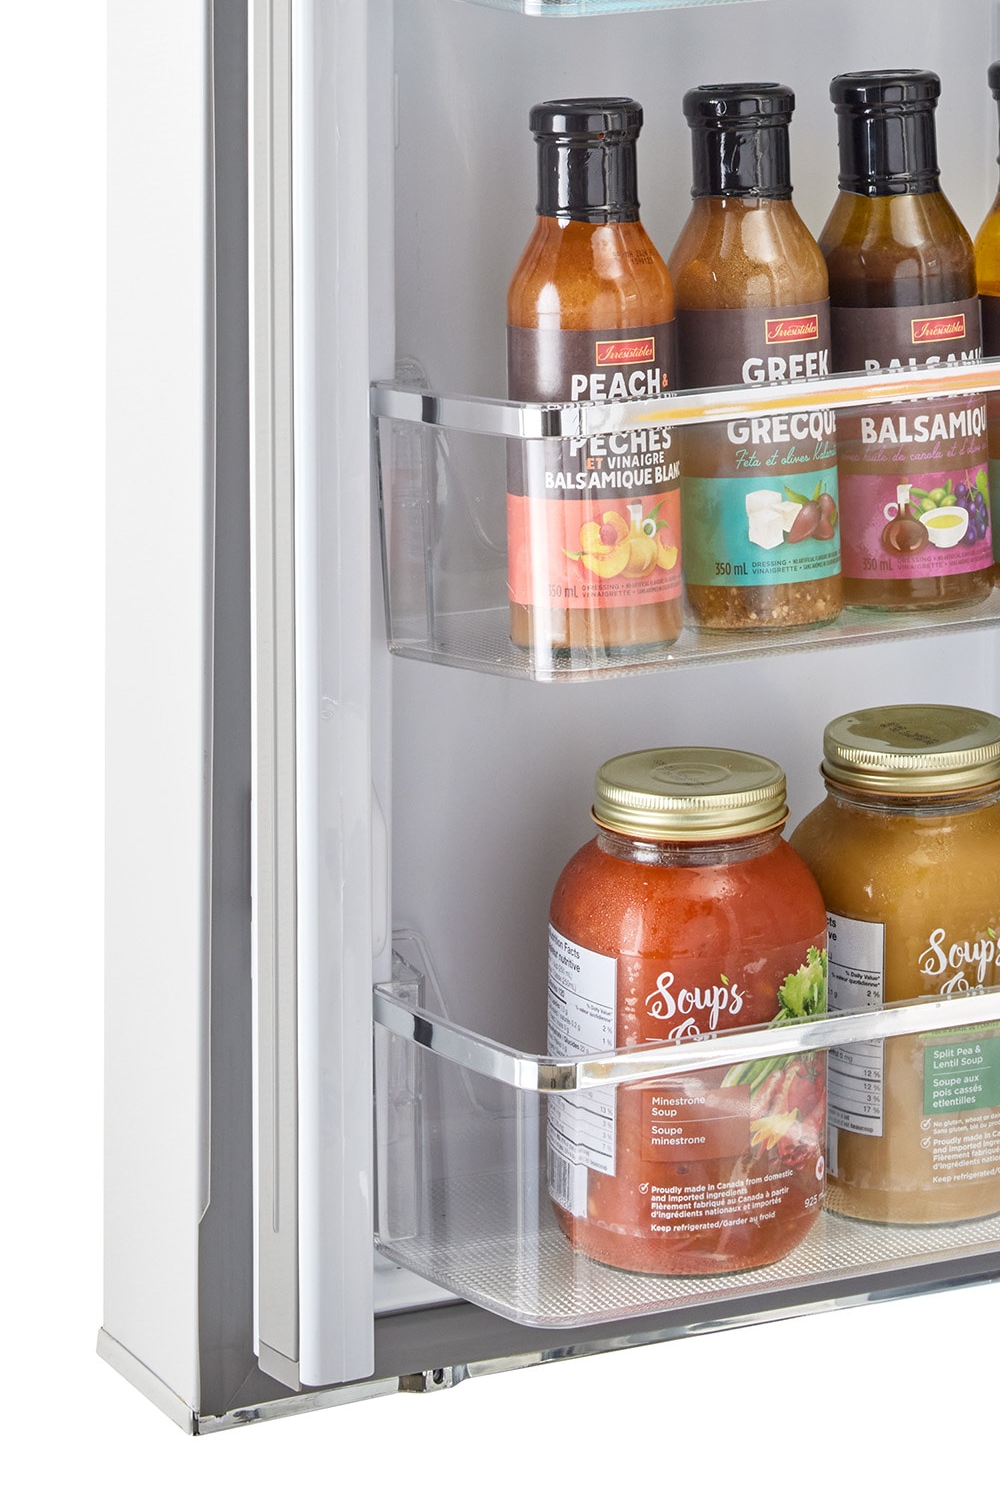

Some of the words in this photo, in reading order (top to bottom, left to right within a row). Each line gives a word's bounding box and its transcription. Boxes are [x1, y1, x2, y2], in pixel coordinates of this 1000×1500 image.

[742, 349, 828, 385] GREEK
[571, 368, 661, 401] PEACH
[861, 404, 986, 444] BALSAMIQU
[910, 441, 944, 461] canola
[586, 458, 604, 469] ET
[607, 451, 665, 469] VINAIGRE
[735, 449, 761, 469] Feta
[545, 468, 653, 490] BALSAMIQUE
[715, 563, 731, 575] 350
[734, 562, 748, 575] mL
[752, 560, 786, 568] DRESSING
[752, 566, 798, 575] VINAIGRETTE
[851, 971, 863, 980] Daily
[933, 1049, 954, 1059] Split
[957, 1047, 973, 1056] Pea
[933, 1057, 959, 1070] Lentil
[961, 1056, 984, 1067] Soup
[933, 1077, 961, 1088] Soupe
[963, 1074, 979, 1083] aux
[932, 1088, 952, 1099] pois
[954, 1085, 982, 1095] cassés
[651, 1097, 705, 1106] Minestrone
[651, 1108, 677, 1117] Soup
[651, 1126, 683, 1136] Soupe
[651, 1136, 706, 1145] minestrone
[933, 1137, 961, 1146] Proudly
[963, 1133, 983, 1142] made
[933, 1152, 970, 1162] Fièrement
[971, 1147, 1000, 1159] fabriqué
[949, 1142, 982, 1153] imported
[932, 1160, 980, 1170] d'ingrédients
[651, 1186, 682, 1195] Proudly
[684, 1184, 706, 1193] made
[716, 1180, 744, 1190] Canada
[746, 1176, 763, 1186] from
[764, 1169, 794, 1182] domestic
[932, 1174, 952, 1184] Keep
[651, 1194, 666, 1202] and
[668, 1193, 704, 1204] imported
[706, 1188, 747, 1200] ingredients
[651, 1201, 692, 1210] Fièrement
[693, 1198, 725, 1209] fabriqué
[737, 1194, 764, 1203] Canada
[771, 1186, 789, 1199] partir
[651, 1209, 702, 1219] d'ingrédients
[704, 1206, 741, 1216] nationaux
[752, 1197, 782, 1211] importés
[651, 1224, 672, 1233] Keep
[673, 1217, 748, 1232] refrigerated/Garder
[759, 1211, 776, 1221] froid
